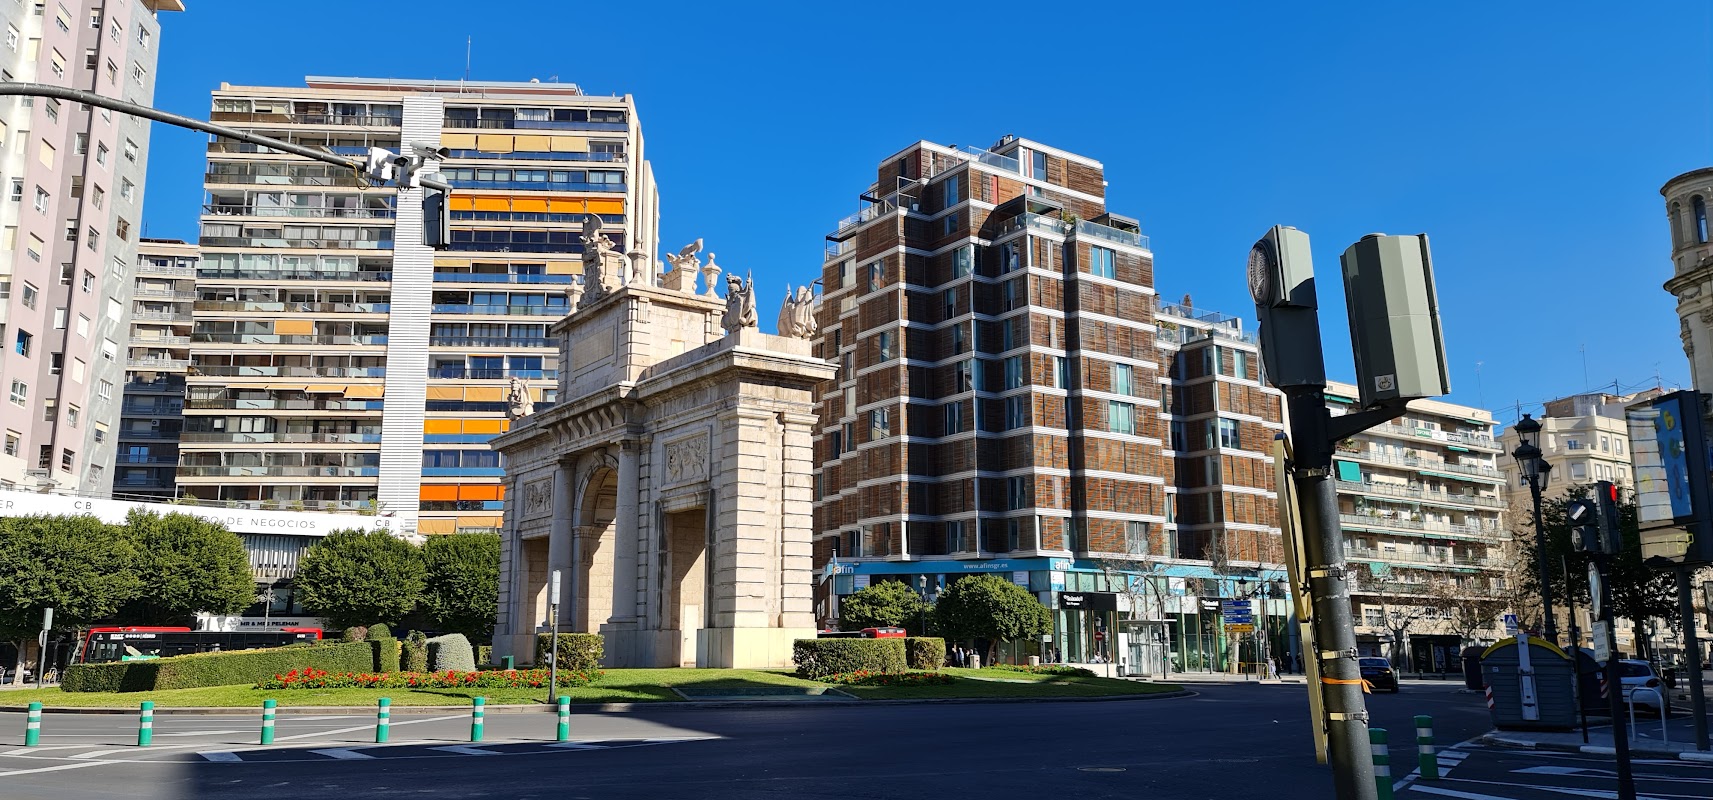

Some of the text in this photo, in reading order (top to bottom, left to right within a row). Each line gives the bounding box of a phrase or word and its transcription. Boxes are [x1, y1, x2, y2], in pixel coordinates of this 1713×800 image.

[227, 517, 243, 525] DE
[251, 518, 316, 529] NEGOCIOS
[836, 565, 854, 574] afin
[1055, 561, 1070, 570] afin
